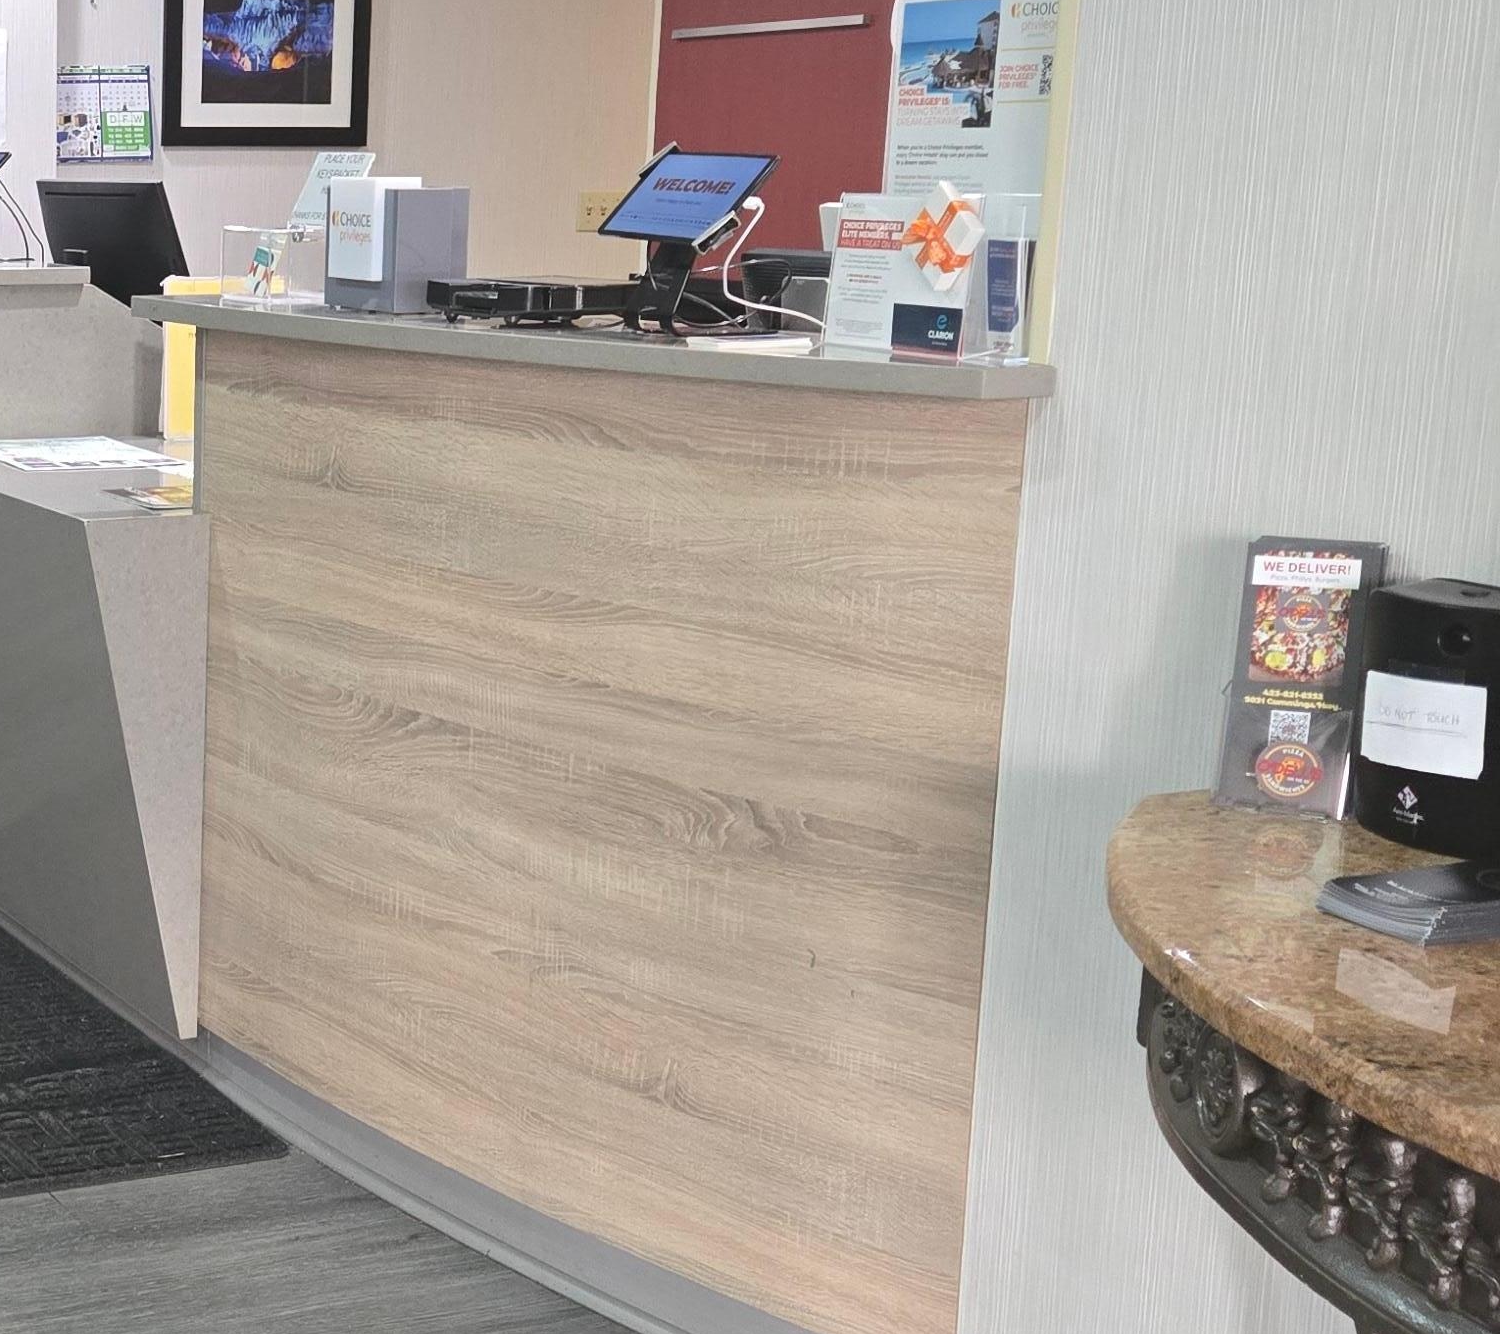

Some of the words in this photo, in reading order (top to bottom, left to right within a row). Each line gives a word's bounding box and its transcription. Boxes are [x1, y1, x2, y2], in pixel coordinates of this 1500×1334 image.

[1015, 63, 1038, 73] CHOICE
[898, 87, 925, 97] CHOICE
[324, 153, 345, 164] PLACE
[346, 153, 366, 164] YOUR
[652, 177, 736, 195] WELCOME!
[340, 211, 372, 227] CHOICE
[843, 221, 865, 230] CHOICE
[1263, 561, 1285, 572] WE
[1288, 562, 1351, 576] DELIVER!
[1379, 703, 1391, 717] DO
[1394, 706, 1417, 721] NOT
[1424, 712, 1461, 726] TOUCH
